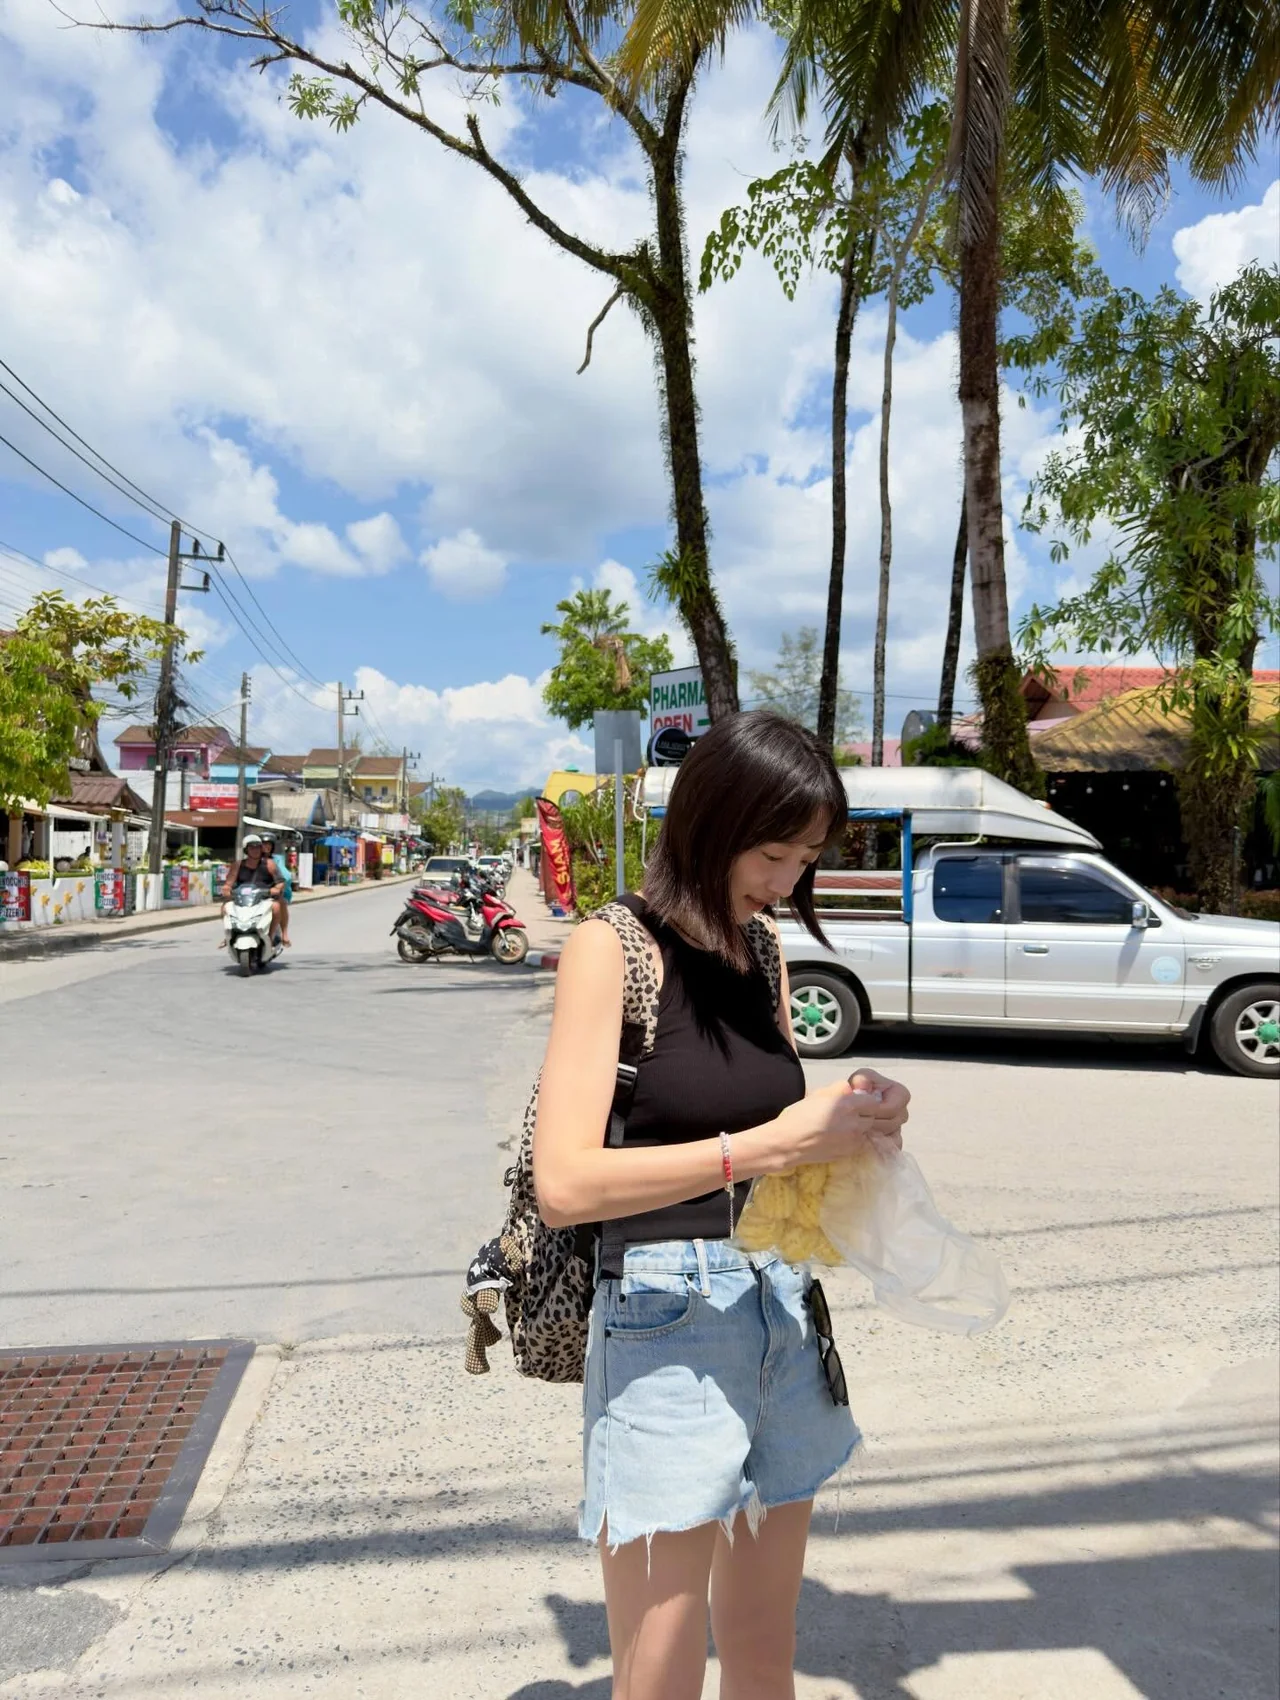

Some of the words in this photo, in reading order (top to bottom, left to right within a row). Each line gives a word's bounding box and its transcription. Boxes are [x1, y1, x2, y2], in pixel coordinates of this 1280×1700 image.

[652, 680, 706, 712] PHARMA
[653, 713, 693, 733] OPEN
[550, 838, 569, 884] SIAM
